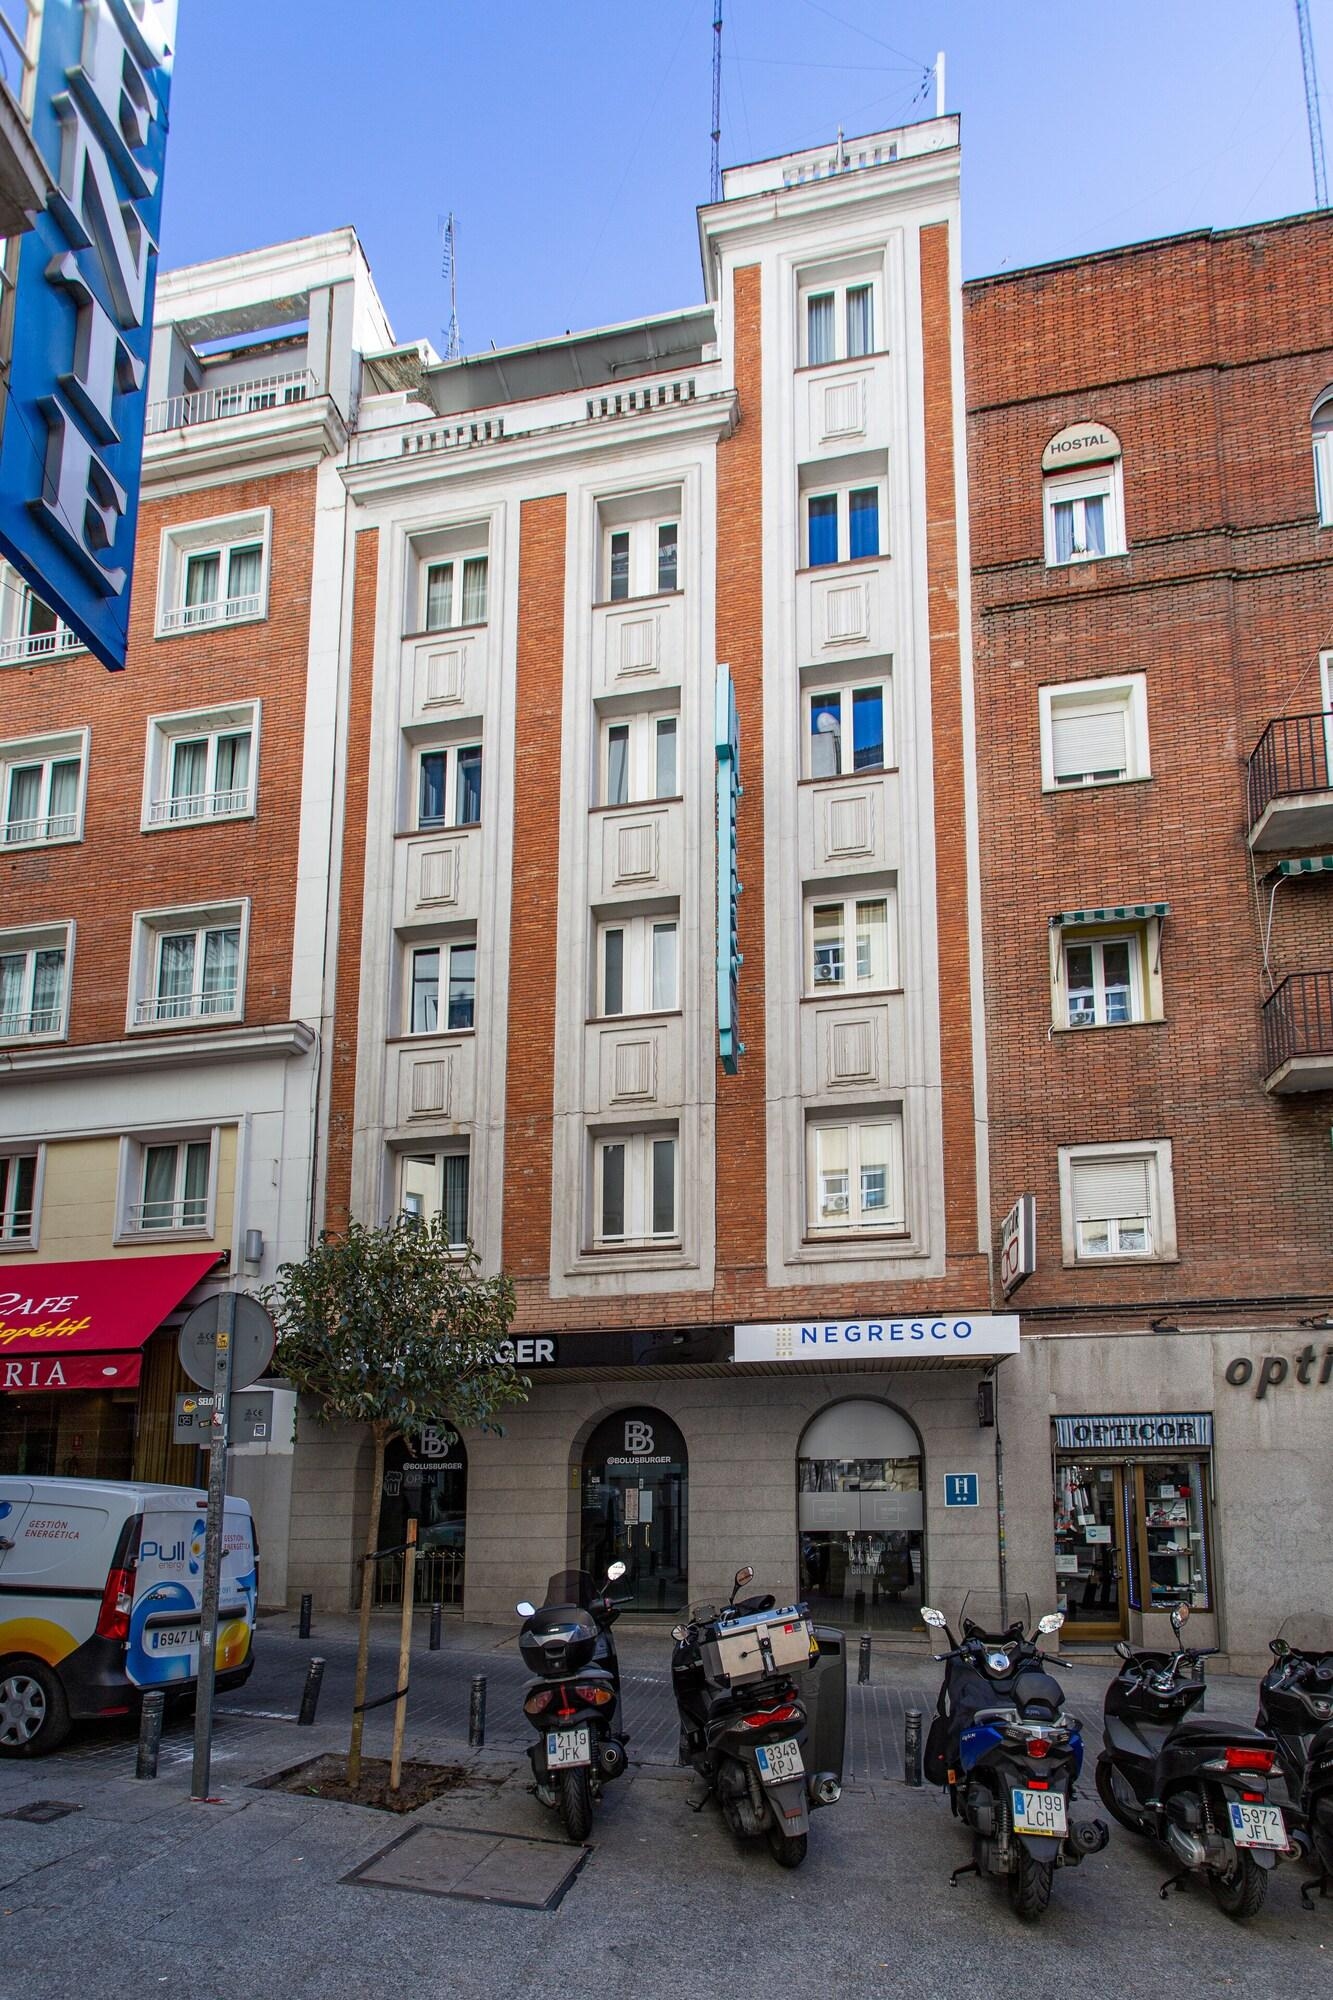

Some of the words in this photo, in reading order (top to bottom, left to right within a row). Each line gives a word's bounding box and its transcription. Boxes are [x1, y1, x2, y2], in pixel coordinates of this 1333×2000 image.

[27, 0, 173, 597] ENTE
[1051, 434, 1109, 454] HOSTAL
[801, 1321, 972, 1344] NEGRESCO
[3, 1361, 67, 1387] RIA
[1074, 1423, 1196, 1442] OPTICOR
[606, 1456, 671, 1465] @BOLUSBURGER
[406, 1474, 436, 1484] OPEN
[25, 1529, 80, 1540] ENERGÉTICA
[140, 1541, 185, 1562] Pull
[158, 1561, 185, 1571] energy
[160, 1631, 187, 1646] 6947
[189, 1630, 201, 1643] LN
[557, 1732, 587, 1749] 2119
[558, 1747, 580, 1762] JFK
[767, 1742, 798, 1761] 3348
[770, 1757, 794, 1776] KPJ
[1025, 1793, 1062, 1811] 7199
[1026, 1811, 1055, 1828] LCH
[1241, 1807, 1279, 1826] 5972
[1246, 1824, 1274, 1841] JFL
